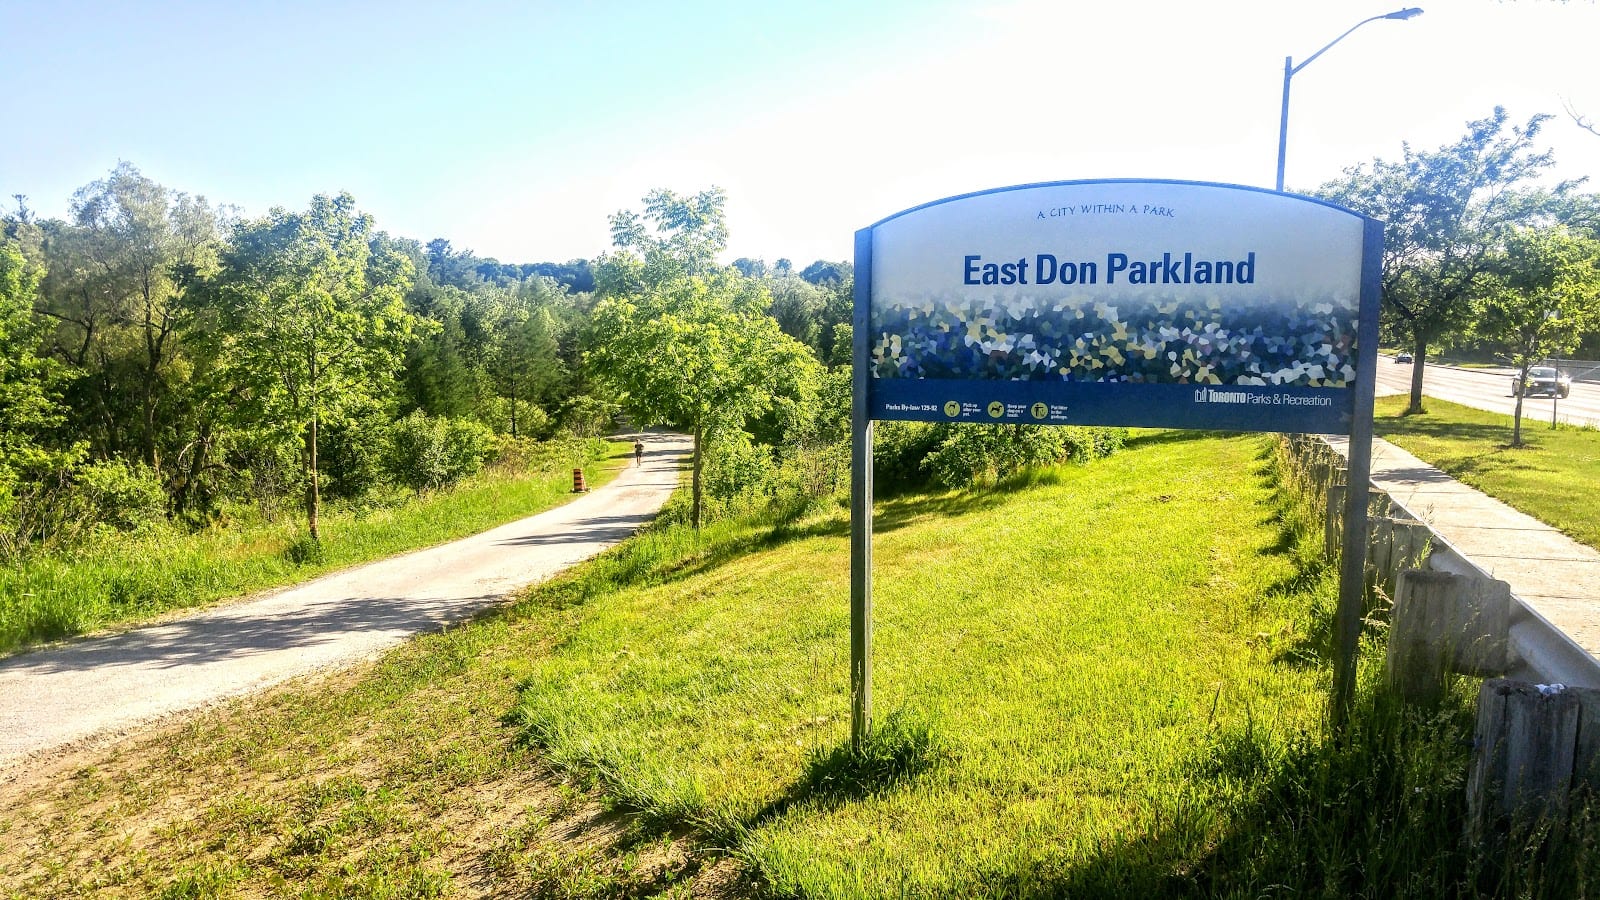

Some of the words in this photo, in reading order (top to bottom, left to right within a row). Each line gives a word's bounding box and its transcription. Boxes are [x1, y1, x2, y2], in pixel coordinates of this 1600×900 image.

[1037, 210, 1046, 219] A
[1050, 205, 1076, 217] CITY
[1081, 204, 1125, 214] WITHIN
[1129, 204, 1138, 214] A
[1143, 205, 1175, 218] PARK
[964, 254, 1029, 285] East
[1035, 253, 1097, 285] Don
[1106, 252, 1256, 285] Parkland
[1207, 389, 1246, 404] TORONTO
[1247, 393, 1271, 405] Parks
[1273, 394, 1281, 405] &
[1282, 394, 1332, 407] Recreation
[885, 403, 901, 411] Parks
